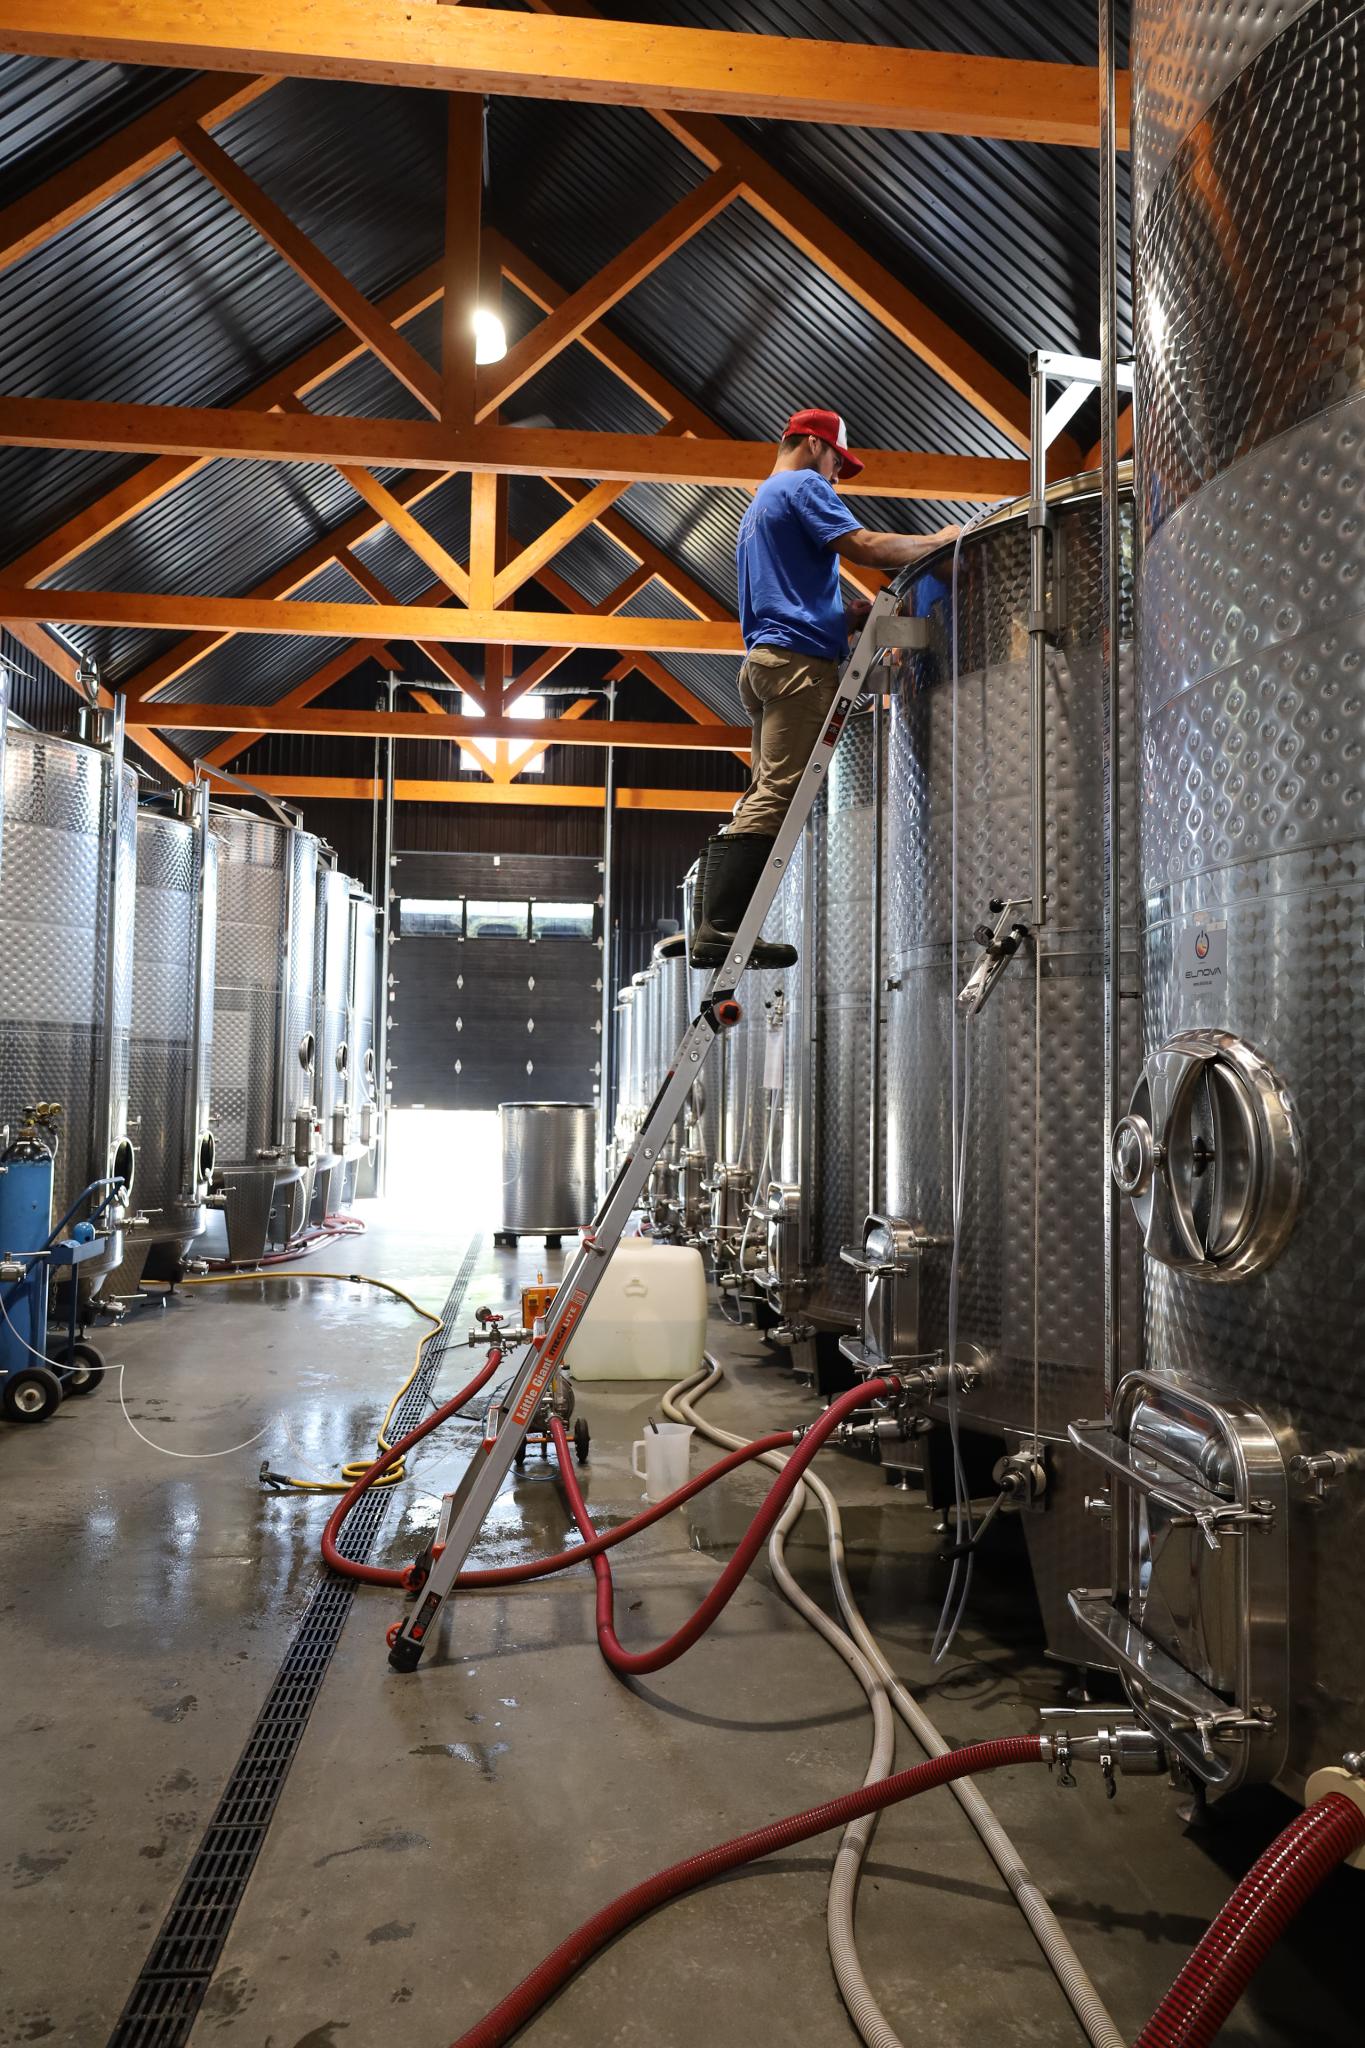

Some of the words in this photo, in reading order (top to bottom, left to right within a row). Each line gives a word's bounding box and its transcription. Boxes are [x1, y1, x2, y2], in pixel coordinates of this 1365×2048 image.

[1185, 967, 1222, 979] ELNOVA
[516, 1389, 538, 1420] Little
[533, 1358, 553, 1388] Giant
